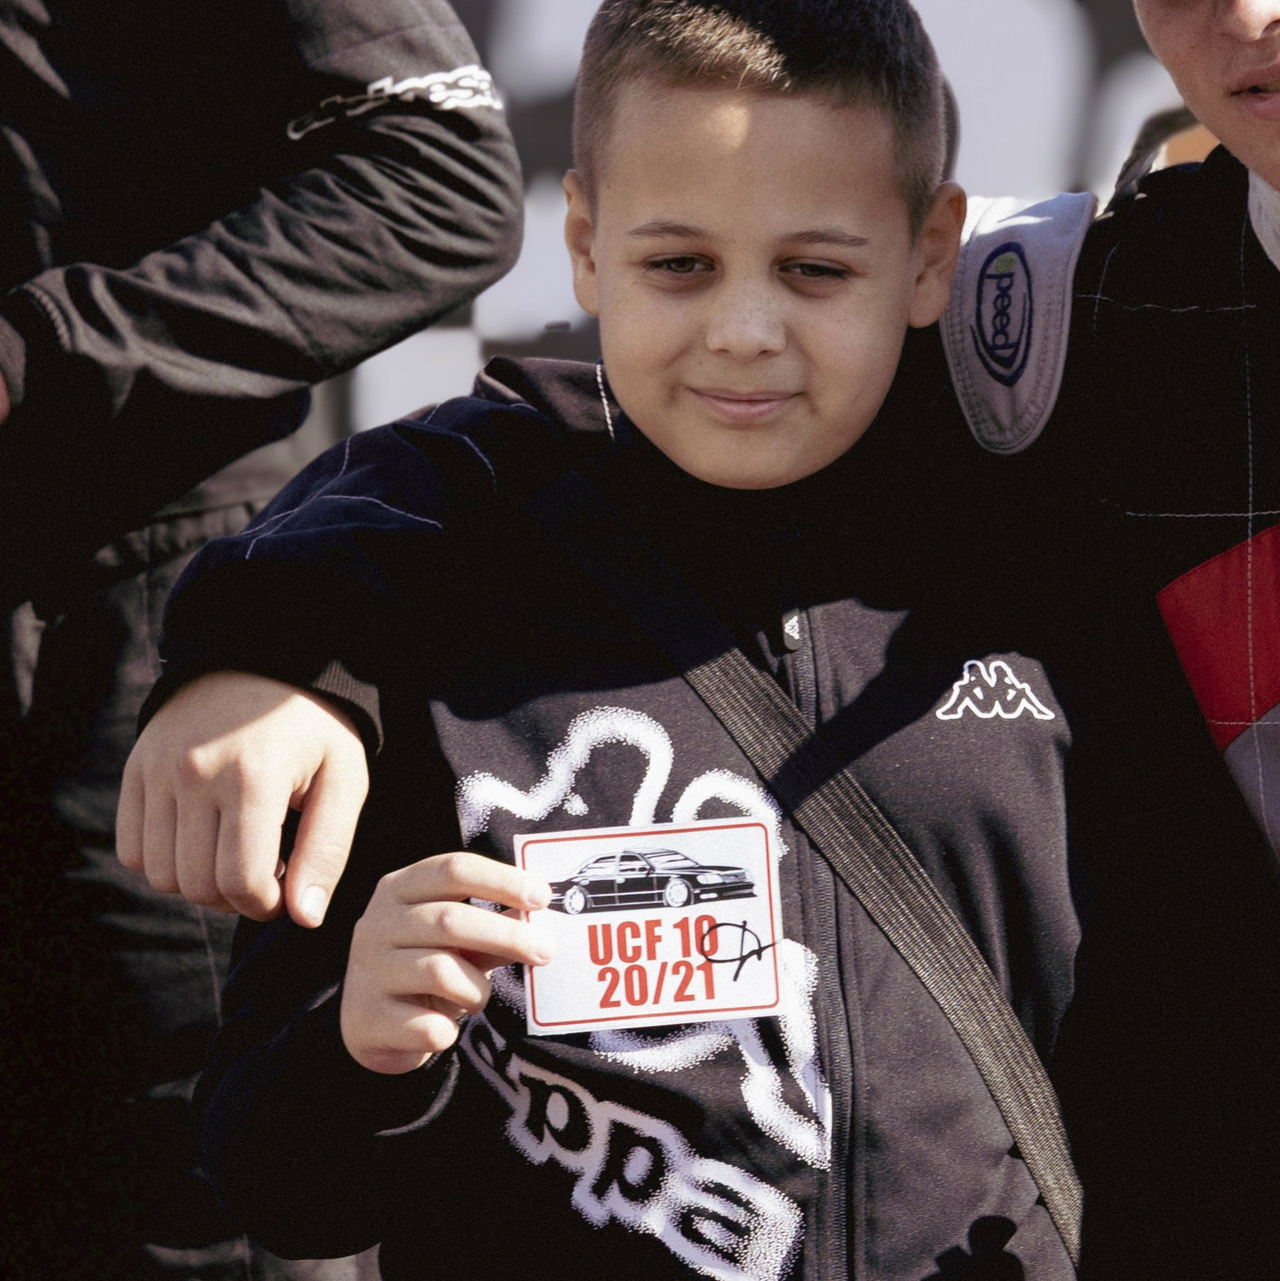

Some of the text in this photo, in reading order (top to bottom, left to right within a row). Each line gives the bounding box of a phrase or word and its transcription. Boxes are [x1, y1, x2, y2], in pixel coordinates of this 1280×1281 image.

[587, 919, 663, 966] UCF
[672, 914, 719, 959] 10
[597, 960, 715, 1009] 20/21
